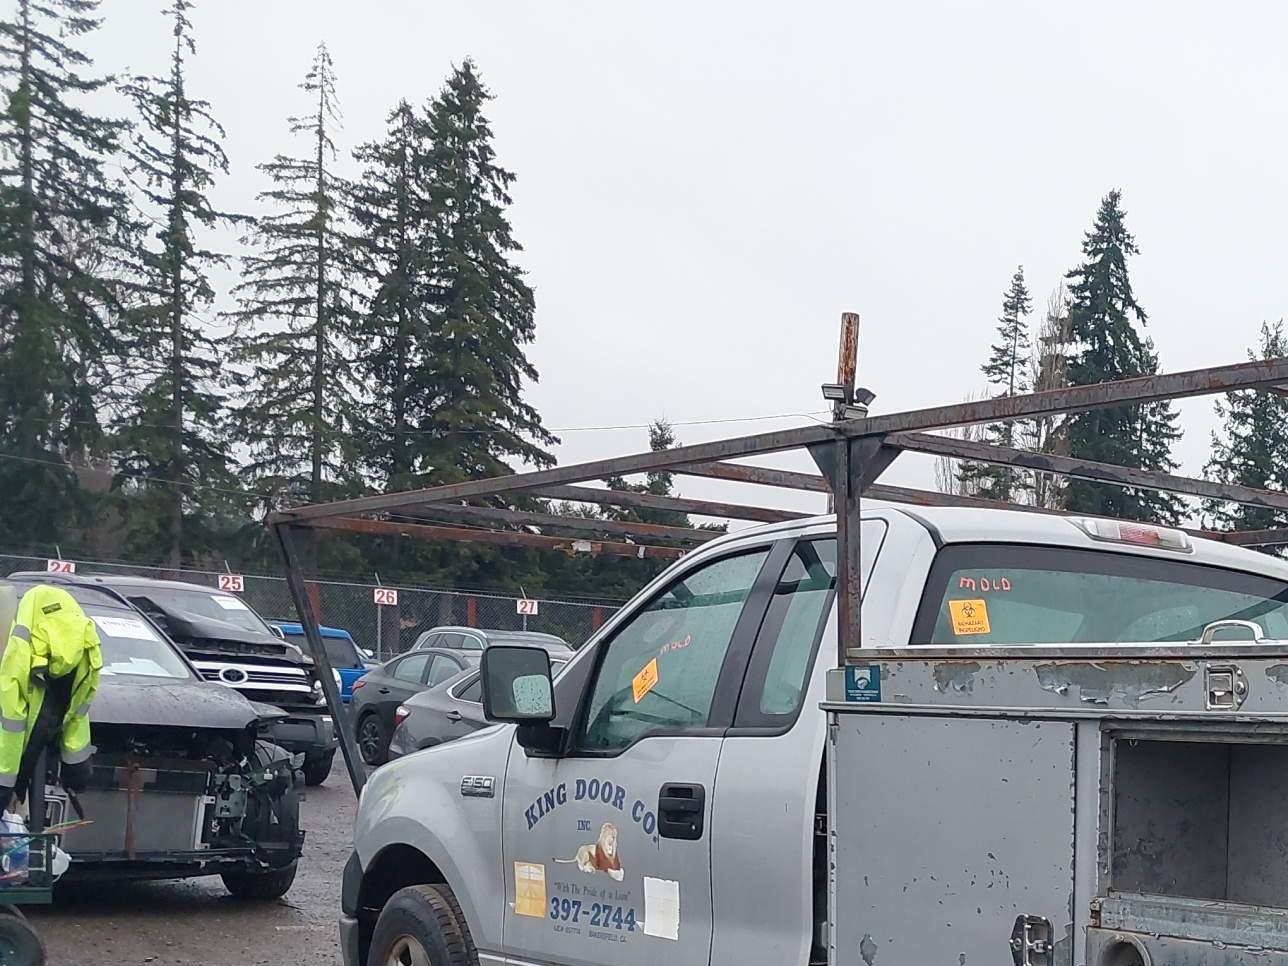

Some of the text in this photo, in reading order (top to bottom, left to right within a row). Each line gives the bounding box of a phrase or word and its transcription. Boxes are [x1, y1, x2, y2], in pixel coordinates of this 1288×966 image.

[50, 562, 73, 572] 24
[221, 576, 242, 590] 25
[959, 576, 1011, 592] MOLD
[376, 589, 395, 604] 26
[519, 601, 535, 613] 27
[524, 783, 568, 831] KING
[574, 778, 626, 811] DOOR
[550, 896, 636, 932] 397-2744
